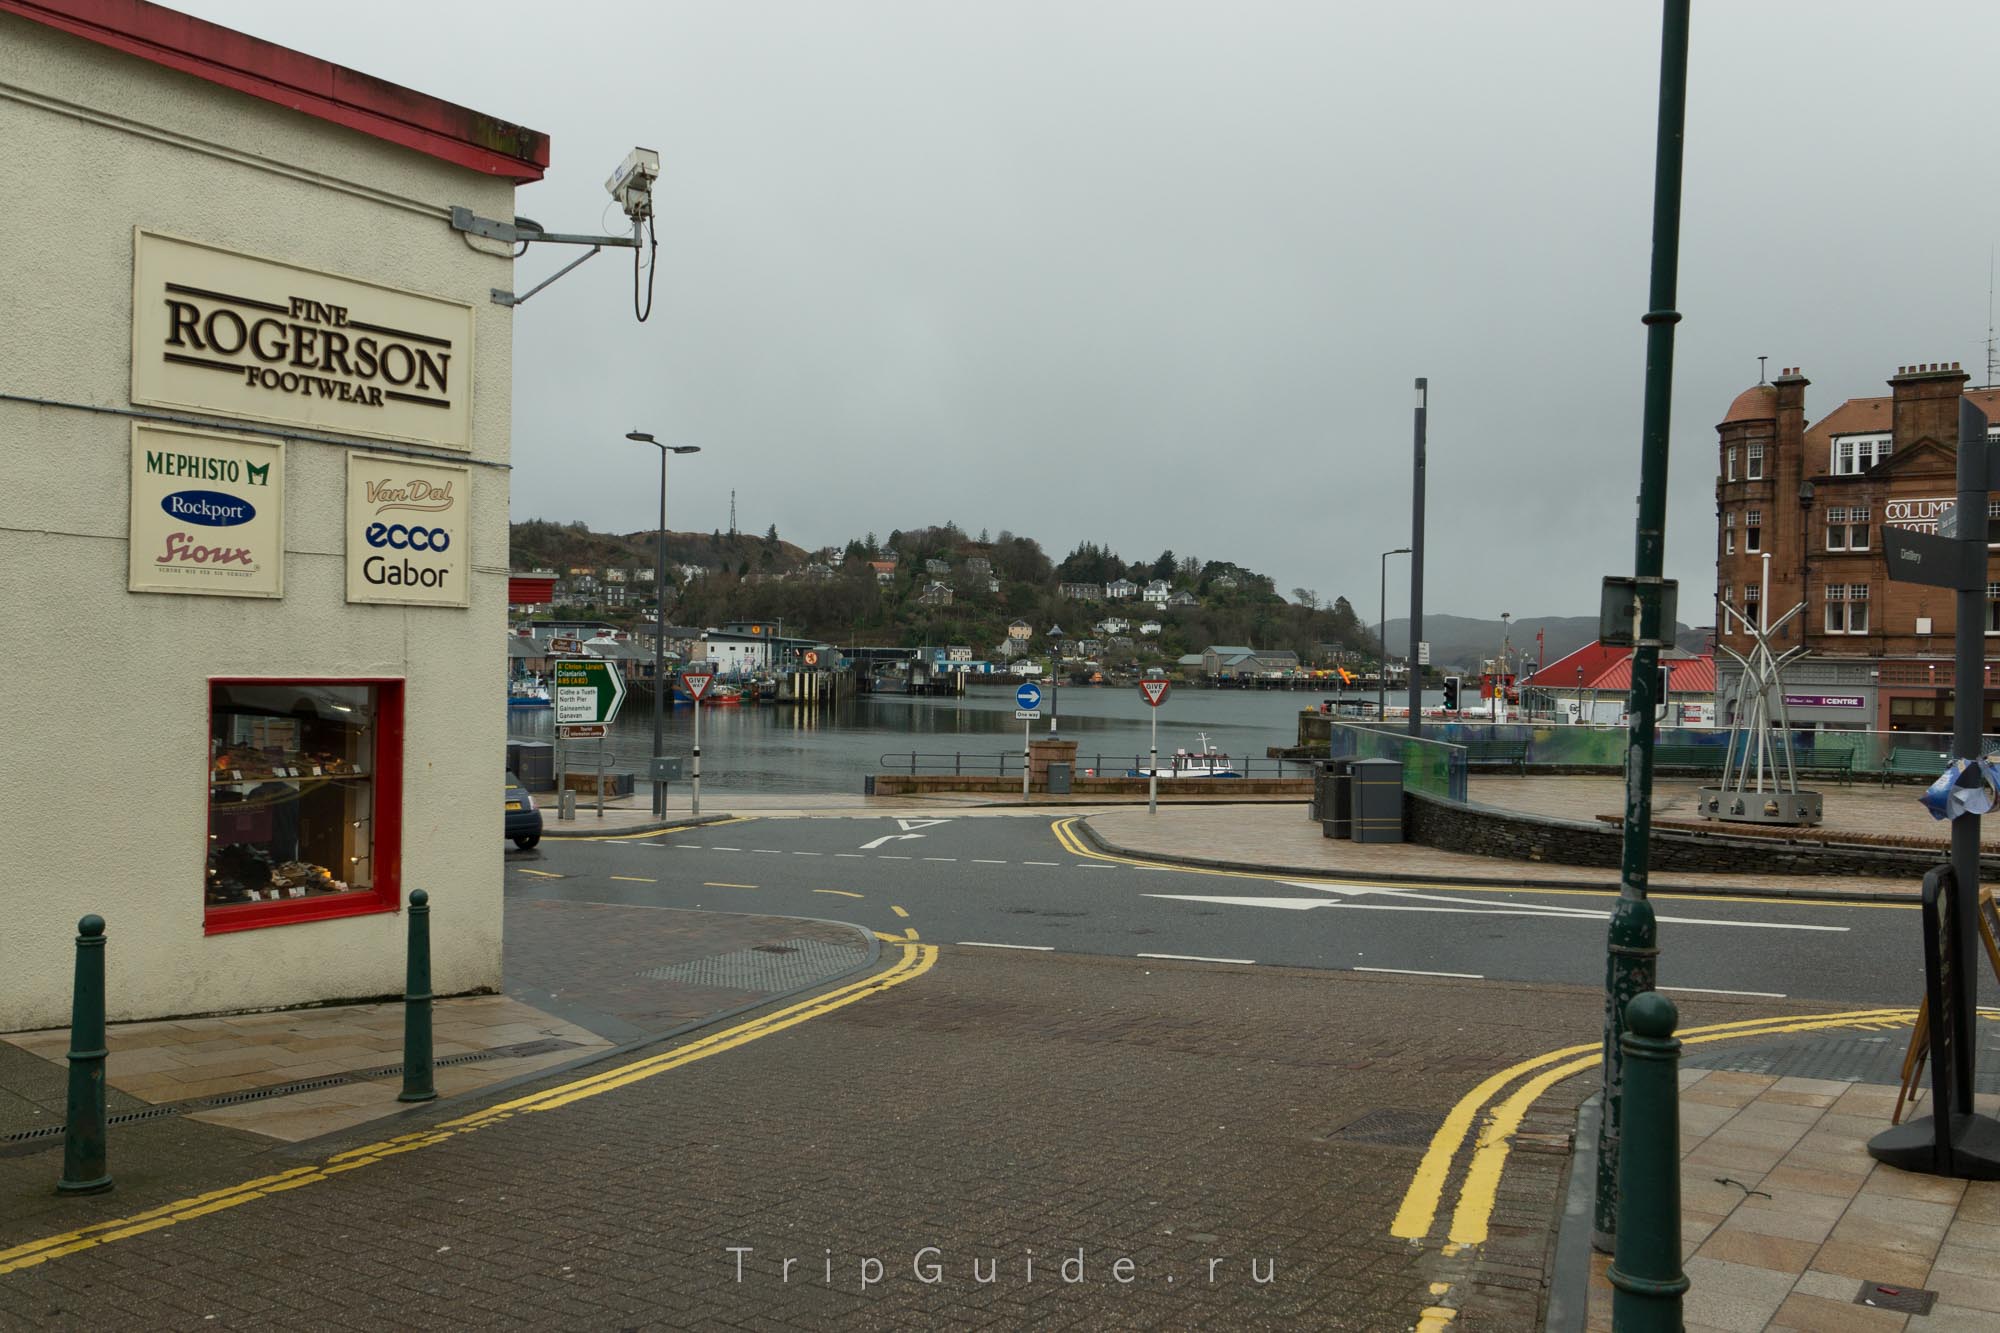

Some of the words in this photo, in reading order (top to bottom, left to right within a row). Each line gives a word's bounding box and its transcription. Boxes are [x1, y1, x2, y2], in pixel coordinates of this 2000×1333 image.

[288, 296, 349, 327] FINE
[165, 299, 451, 394] ROGERSON
[245, 365, 385, 407] FOOTWEAR
[146, 450, 240, 483] MEPHISTO
[366, 479, 408, 504] Van
[407, 480, 454, 502] Dal
[172, 496, 244, 520] Rockport
[156, 532, 253, 566] Sioux
[365, 522, 450, 552] ecco
[363, 556, 449, 588] Gabor
